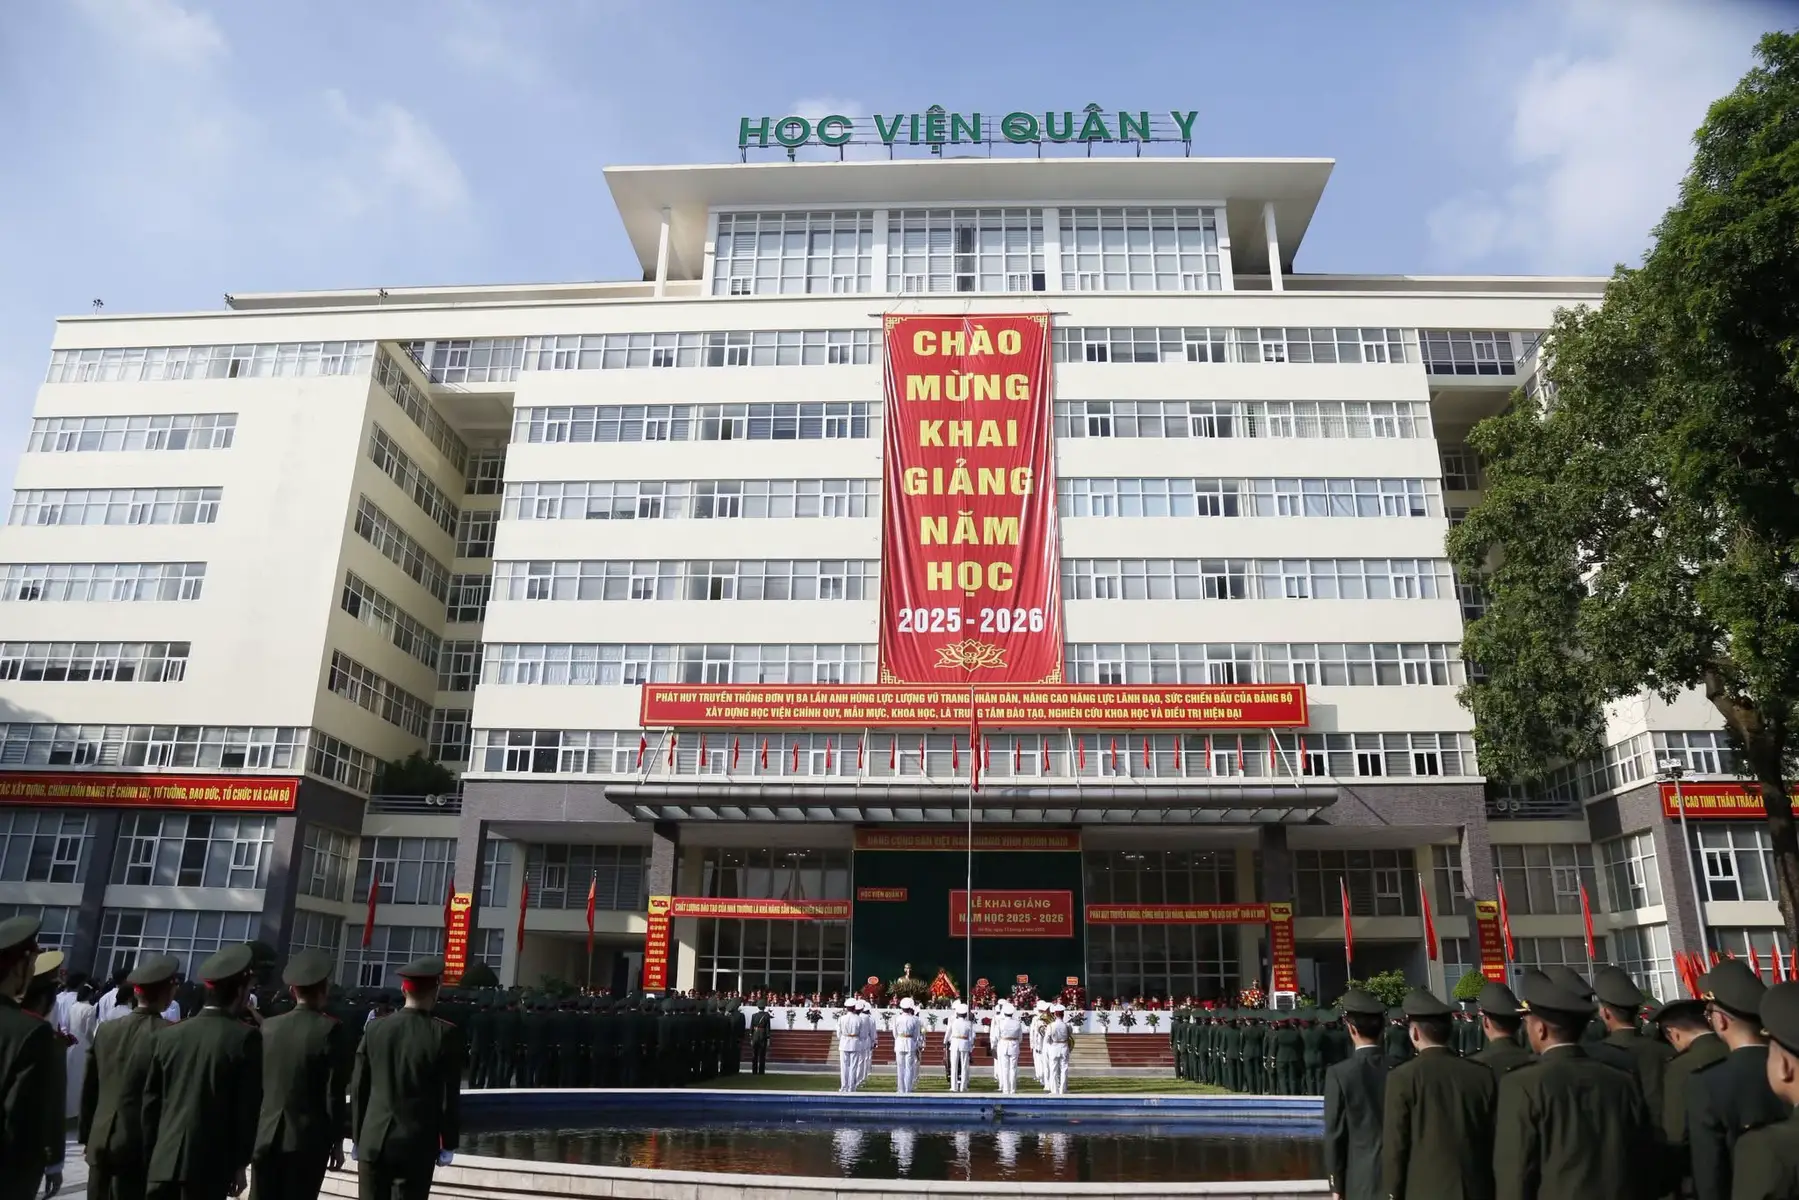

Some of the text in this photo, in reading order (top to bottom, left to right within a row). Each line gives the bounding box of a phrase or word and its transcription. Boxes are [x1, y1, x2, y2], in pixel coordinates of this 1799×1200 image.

[738, 103, 1199, 157] HỌC VIỆN QUÂN Y
[913, 325, 1022, 356] CHÀO
[906, 370, 1029, 401] MỪNG
[919, 419, 1018, 447] KHAI
[903, 458, 1034, 496] GIẢNG
[920, 508, 1020, 545] NĂM
[927, 561, 1013, 597] HỌC
[897, 607, 1044, 634] 2025 - 2026
[655, 691, 678, 703] PHÁT
[680, 693, 697, 703] HUY
[699, 690, 732, 703] TRUYỀN
[735, 690, 763, 703] THỐNG
[765, 693, 784, 703] ĐƠN
[785, 693, 794, 706] VỊ
[796, 693, 808, 703] BA
[810, 691, 829, 703] LẦN
[829, 693, 848, 703] ANH
[850, 692, 875, 703] HÙNG
[876, 692, 894, 705] LỰC
[896, 692, 926, 705] LƯỢNG
[927, 692, 939, 703] VŨ
[941, 693, 970, 703] TRANG
[1000, 692, 1021, 705] DÂN,
[1023, 692, 1048, 704] NÂNG
[1050, 693, 1068, 704] CAO
[1070, 692, 1096, 704] NĂNG
[1097, 692, 1115, 706] LỰC
[1116, 692, 1140, 704] LÃNH
[1142, 693, 1163, 706] ĐẠO,
[1165, 691, 1183, 704] SỨC
[1185, 691, 1212, 704] CHIẾN
[1214, 690, 1234, 704] ĐẤU
[1235, 691, 1252, 704] CỦA
[1254, 691, 1279, 704] ĐẢNG
[1280, 692, 1293, 706] BỘ
[705, 705, 1243, 721] XÂY DỰNG HỌC VIỆN CHÍNH QUY, MẪU MỰC, KHOA HỌC, LÀ TRUG TÂM ĐÀO TẠO, NGHIÊN CỨU KHOA HỌC VÀ ĐIỀU TRỊ HIỆN ĐẠI
[116, 783, 139, 798] CHÍNH
[139, 786, 152, 801] TRỊ,
[153, 785, 163, 799] TƯ
[163, 783, 187, 800] TƯỞNG,
[188, 787, 204, 802] ĐẠO
[205, 785, 221, 801] ĐỨC,
[222, 783, 233, 800] TỔ
[233, 785, 252, 800] CHỨC
[252, 787, 263, 801] VÀ
[263, 786, 279, 801] CÁN
[279, 787, 291, 804] BỘ
[1685, 795, 1699, 808] CAO
[1699, 795, 1717, 808] TINH
[971, 896, 1051, 908] LỄ KHAI GIẢNG
[984, 912, 1004, 924] HỌC
[1006, 912, 1030, 923] 2025
[1039, 912, 1064, 923] 2026
